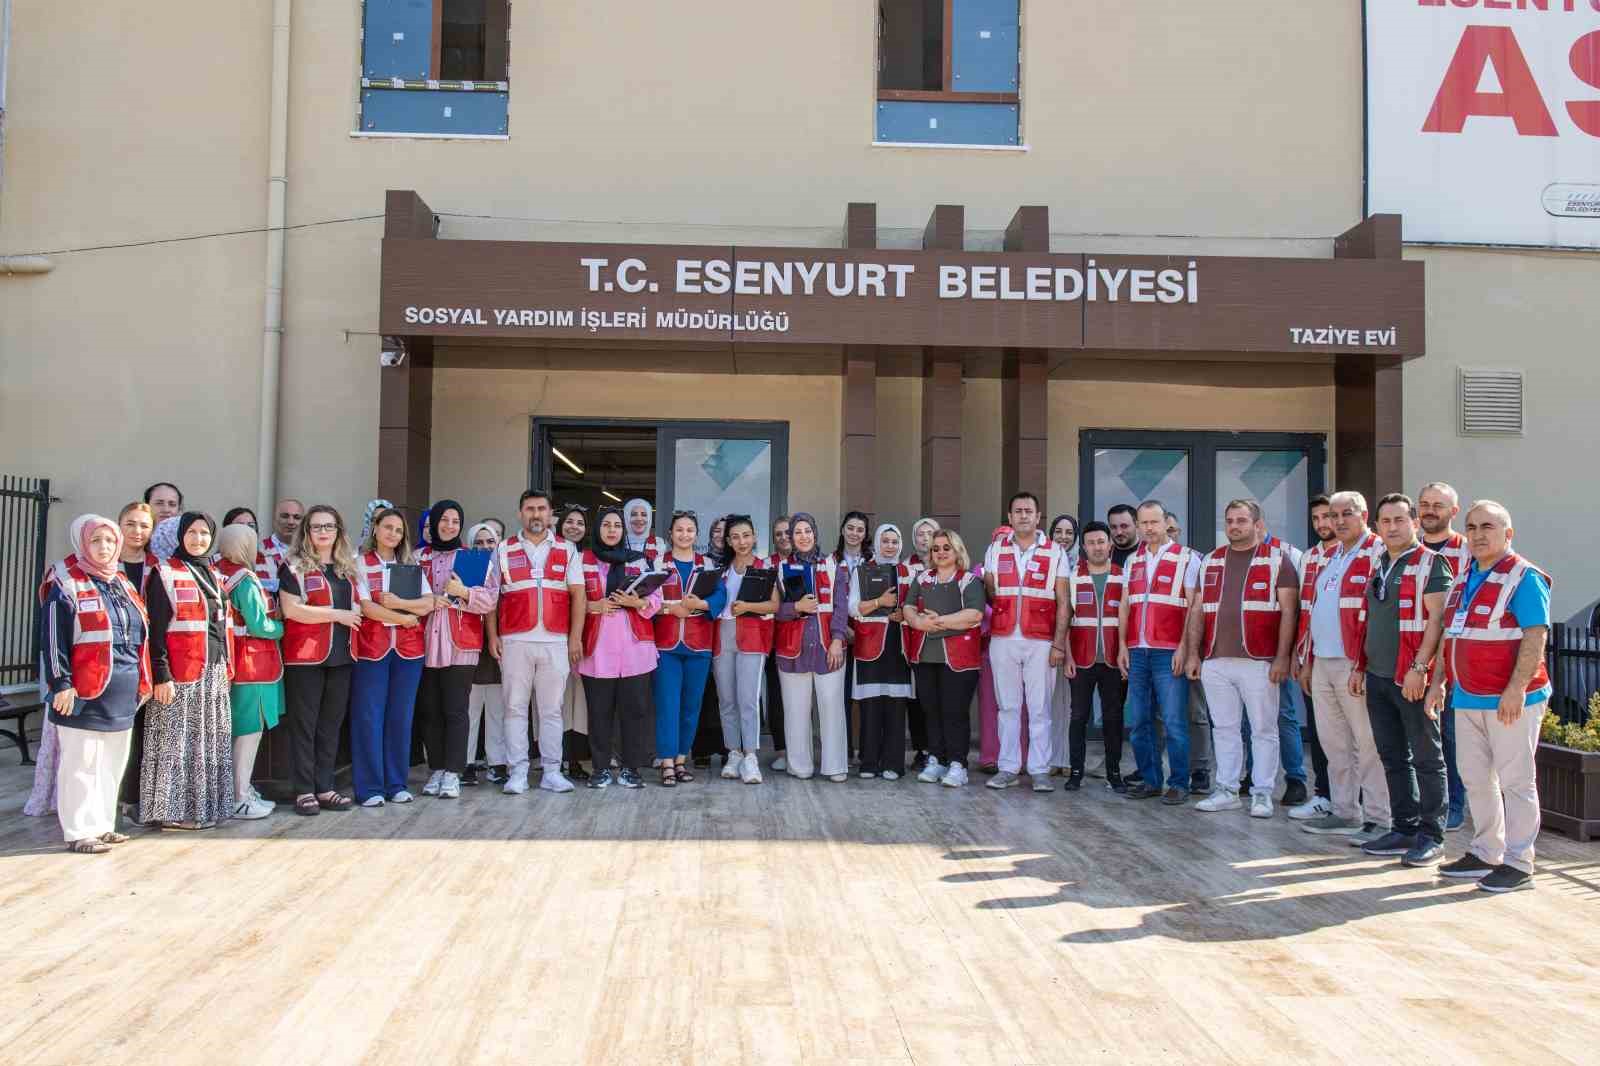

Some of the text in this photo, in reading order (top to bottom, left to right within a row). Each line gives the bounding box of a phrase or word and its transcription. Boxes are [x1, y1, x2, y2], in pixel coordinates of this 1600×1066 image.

[580, 258, 1199, 304] T.C. ESENYURT BELEDİYESİ
[405, 306, 789, 333] SOSYAL YARDIM İŞLERİ MÜDÜRLÜĞÜ
[1290, 325, 1396, 346] TAZİYE EVİ
